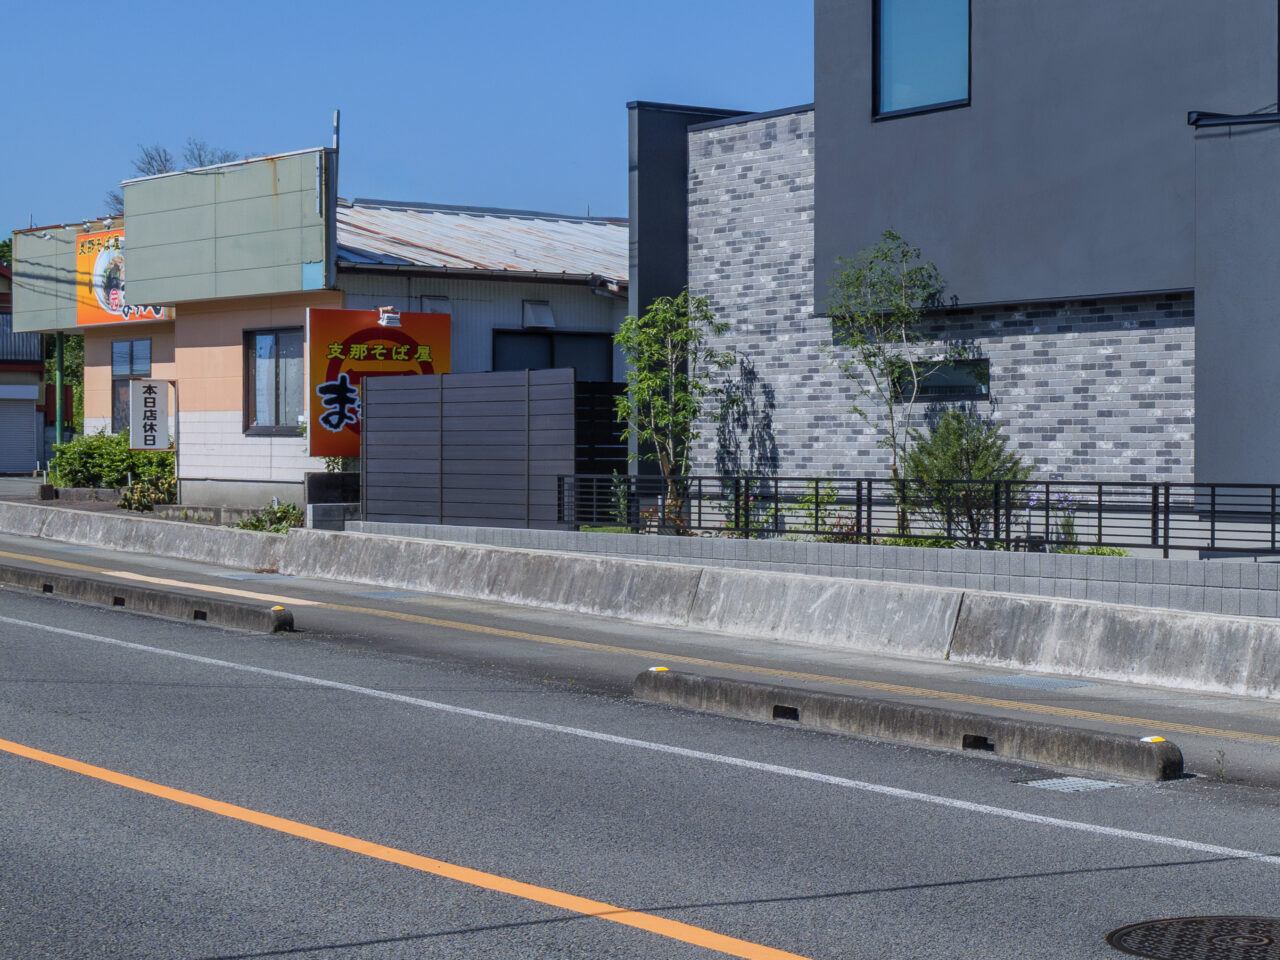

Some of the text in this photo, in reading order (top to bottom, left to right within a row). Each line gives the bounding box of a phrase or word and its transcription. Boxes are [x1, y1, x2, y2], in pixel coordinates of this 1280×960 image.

[326, 343, 433, 362] 支那そば屋
[142, 384, 157, 446] 本日店休日
[316, 373, 361, 432] ま
